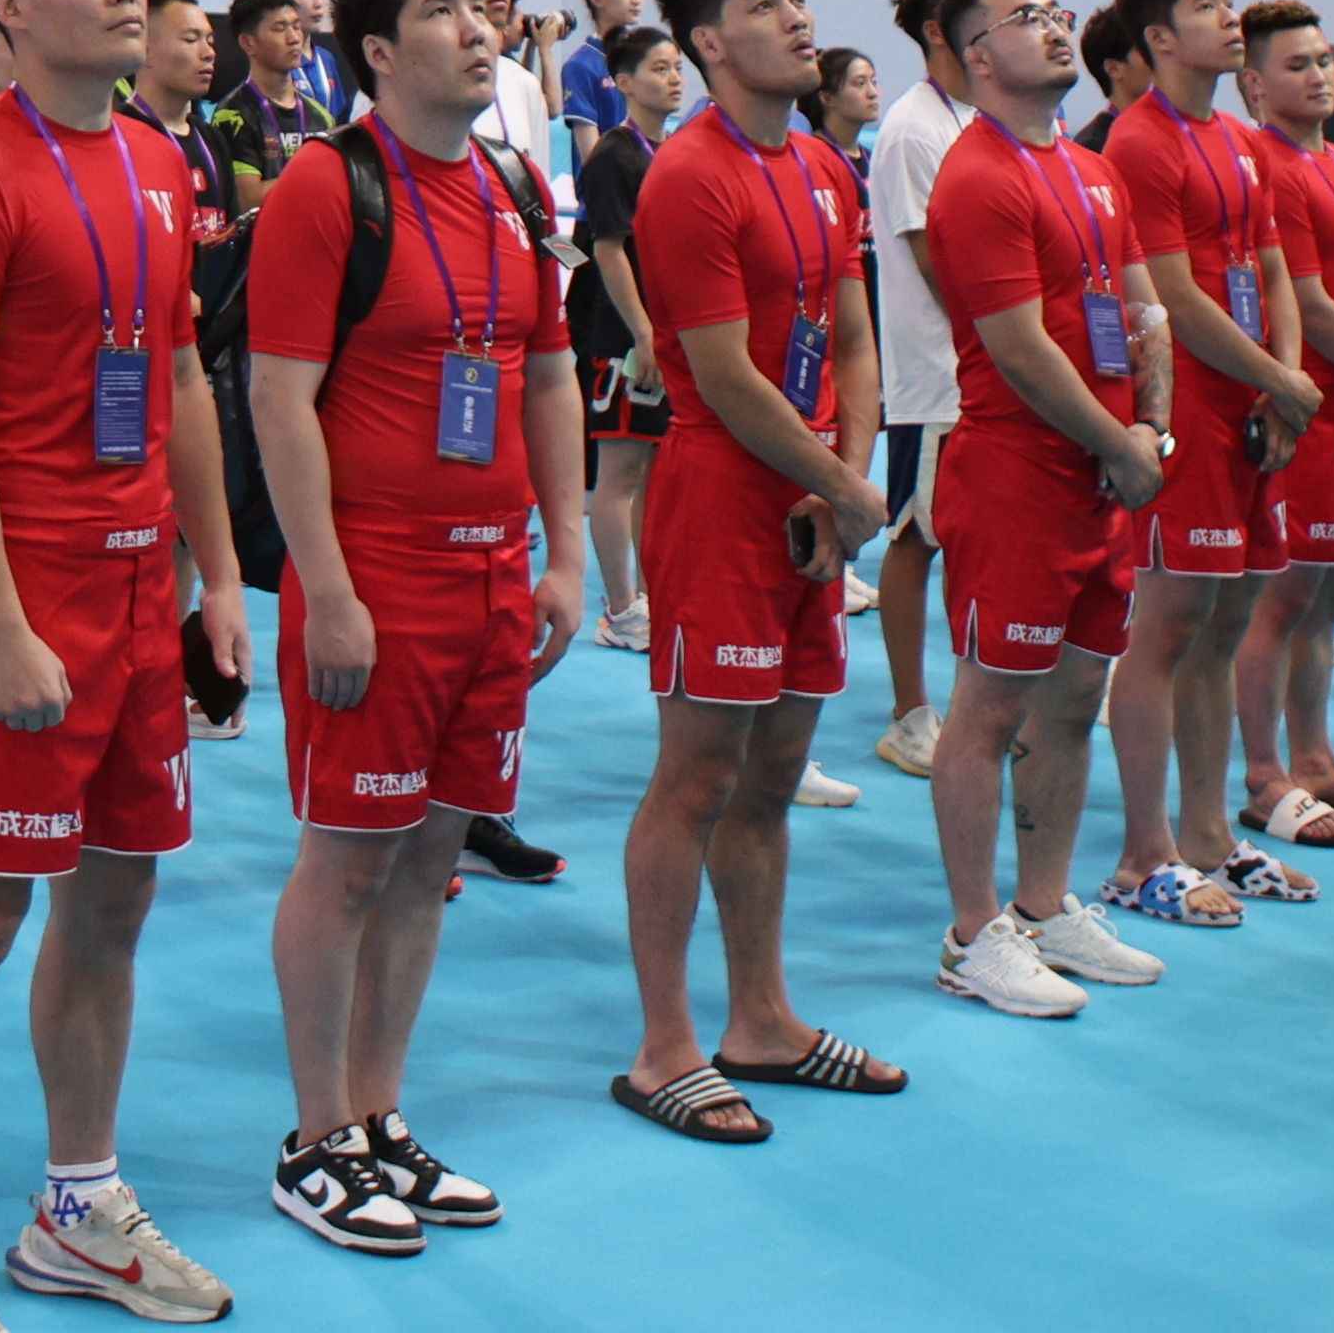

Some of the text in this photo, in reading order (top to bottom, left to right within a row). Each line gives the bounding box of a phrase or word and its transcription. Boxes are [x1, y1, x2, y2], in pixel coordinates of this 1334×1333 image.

[105, 524, 159, 550] 成杰格斗
[355, 766, 428, 797] 成杰格斗
[51, 1183, 92, 1227] LA
